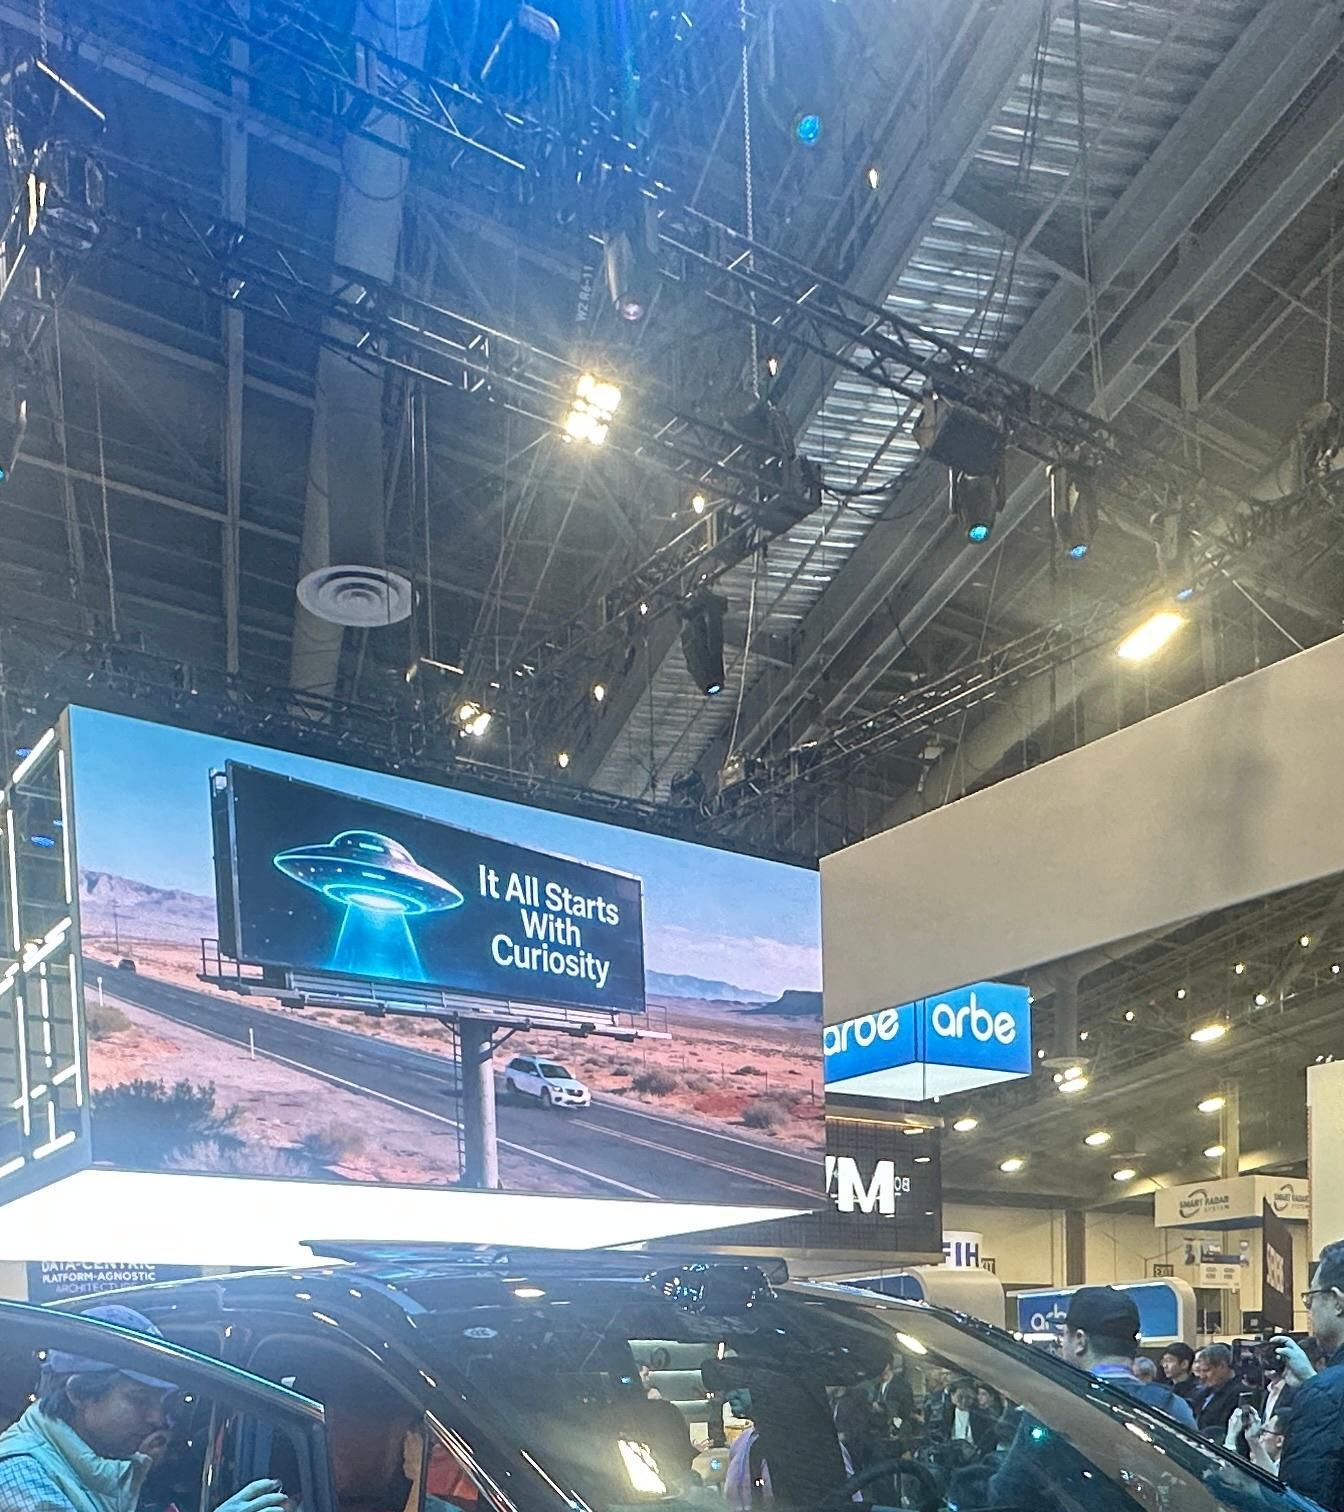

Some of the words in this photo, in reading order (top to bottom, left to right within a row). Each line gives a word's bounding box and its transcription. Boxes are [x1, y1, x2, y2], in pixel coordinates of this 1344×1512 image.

[479, 864, 500, 899] It
[505, 872, 540, 907] All
[545, 882, 620, 925] Starts
[521, 908, 581, 947] With
[492, 934, 610, 989] Curiosity
[932, 992, 1016, 1044] arbe
[42, 1271, 156, 1283] PLATFORM-AGNOSTIC
[942, 1242, 979, 1267] FIH
